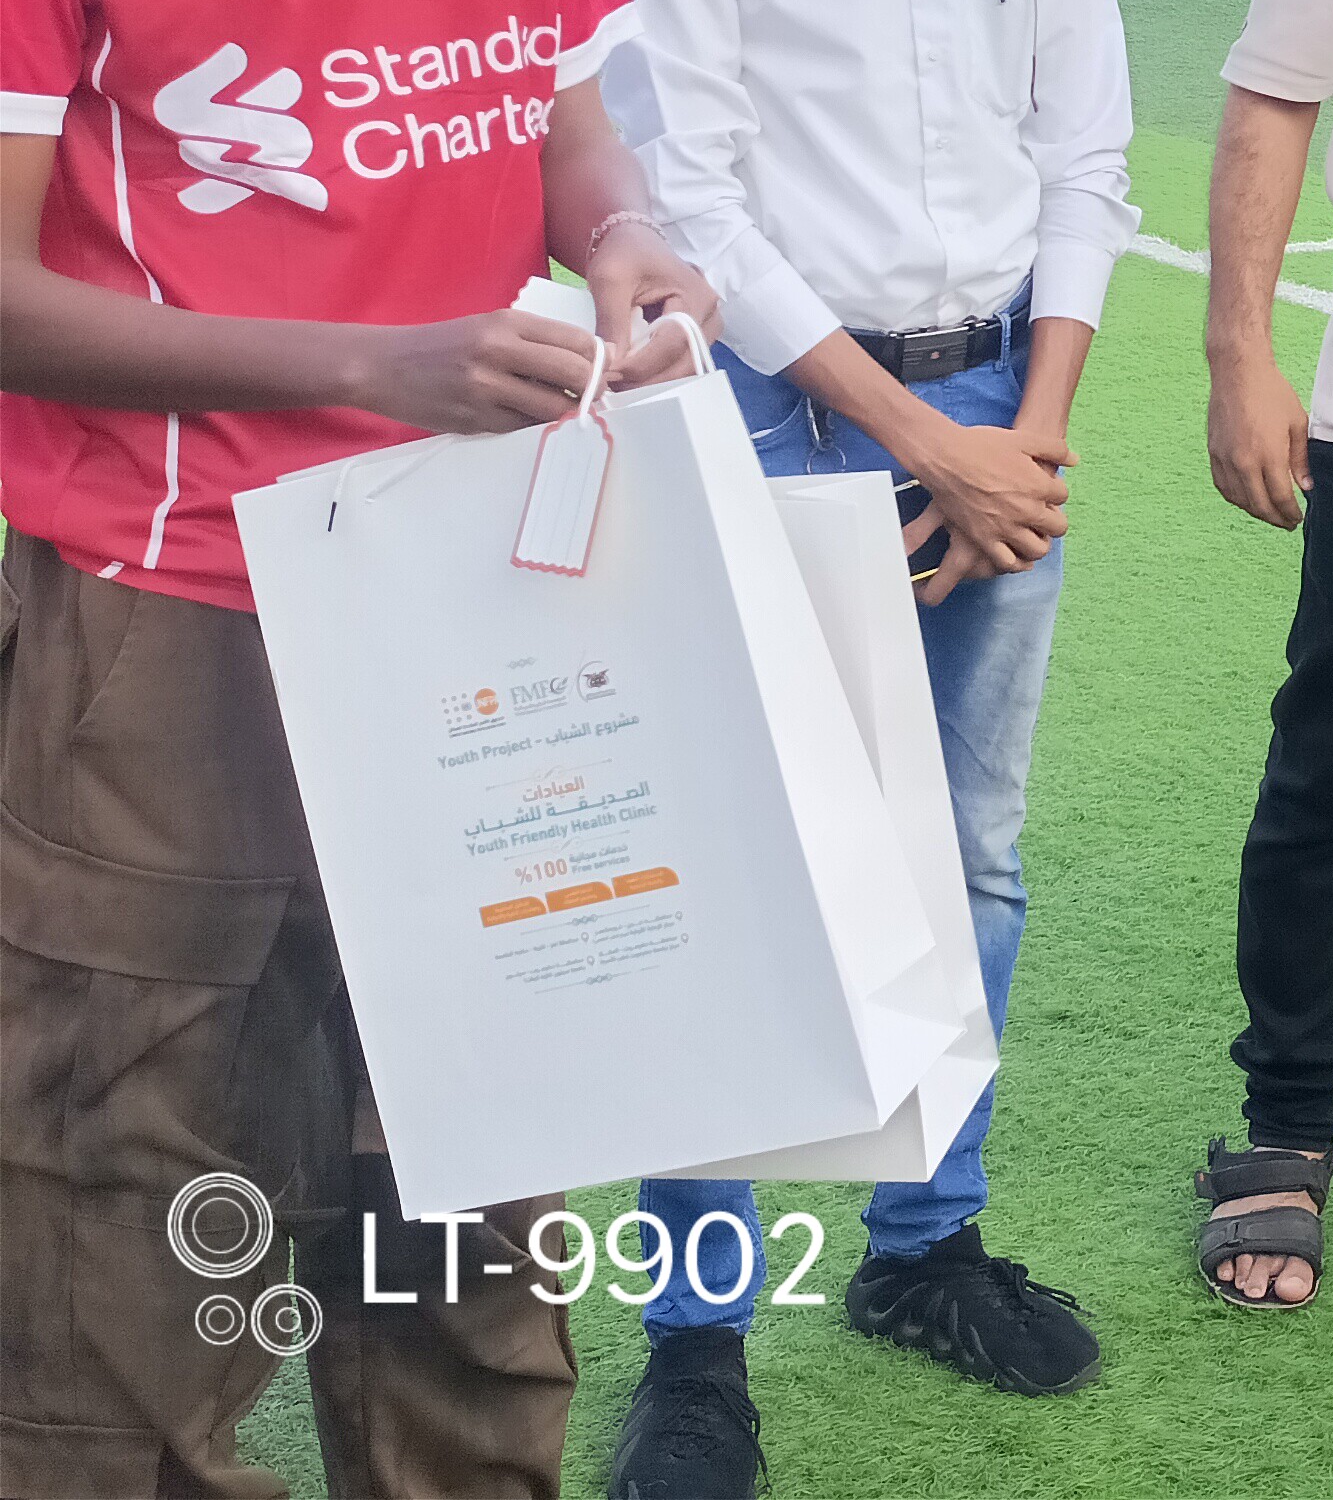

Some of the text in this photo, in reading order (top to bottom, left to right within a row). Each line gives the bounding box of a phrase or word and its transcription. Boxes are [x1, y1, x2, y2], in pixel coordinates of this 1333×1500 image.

[545, 711, 640, 746] مشروع الشباب
[438, 748, 480, 770] Youth
[481, 736, 533, 760] Project
[522, 775, 585, 803] العيادات
[466, 803, 657, 857] Youth Friendly Health Clinic
